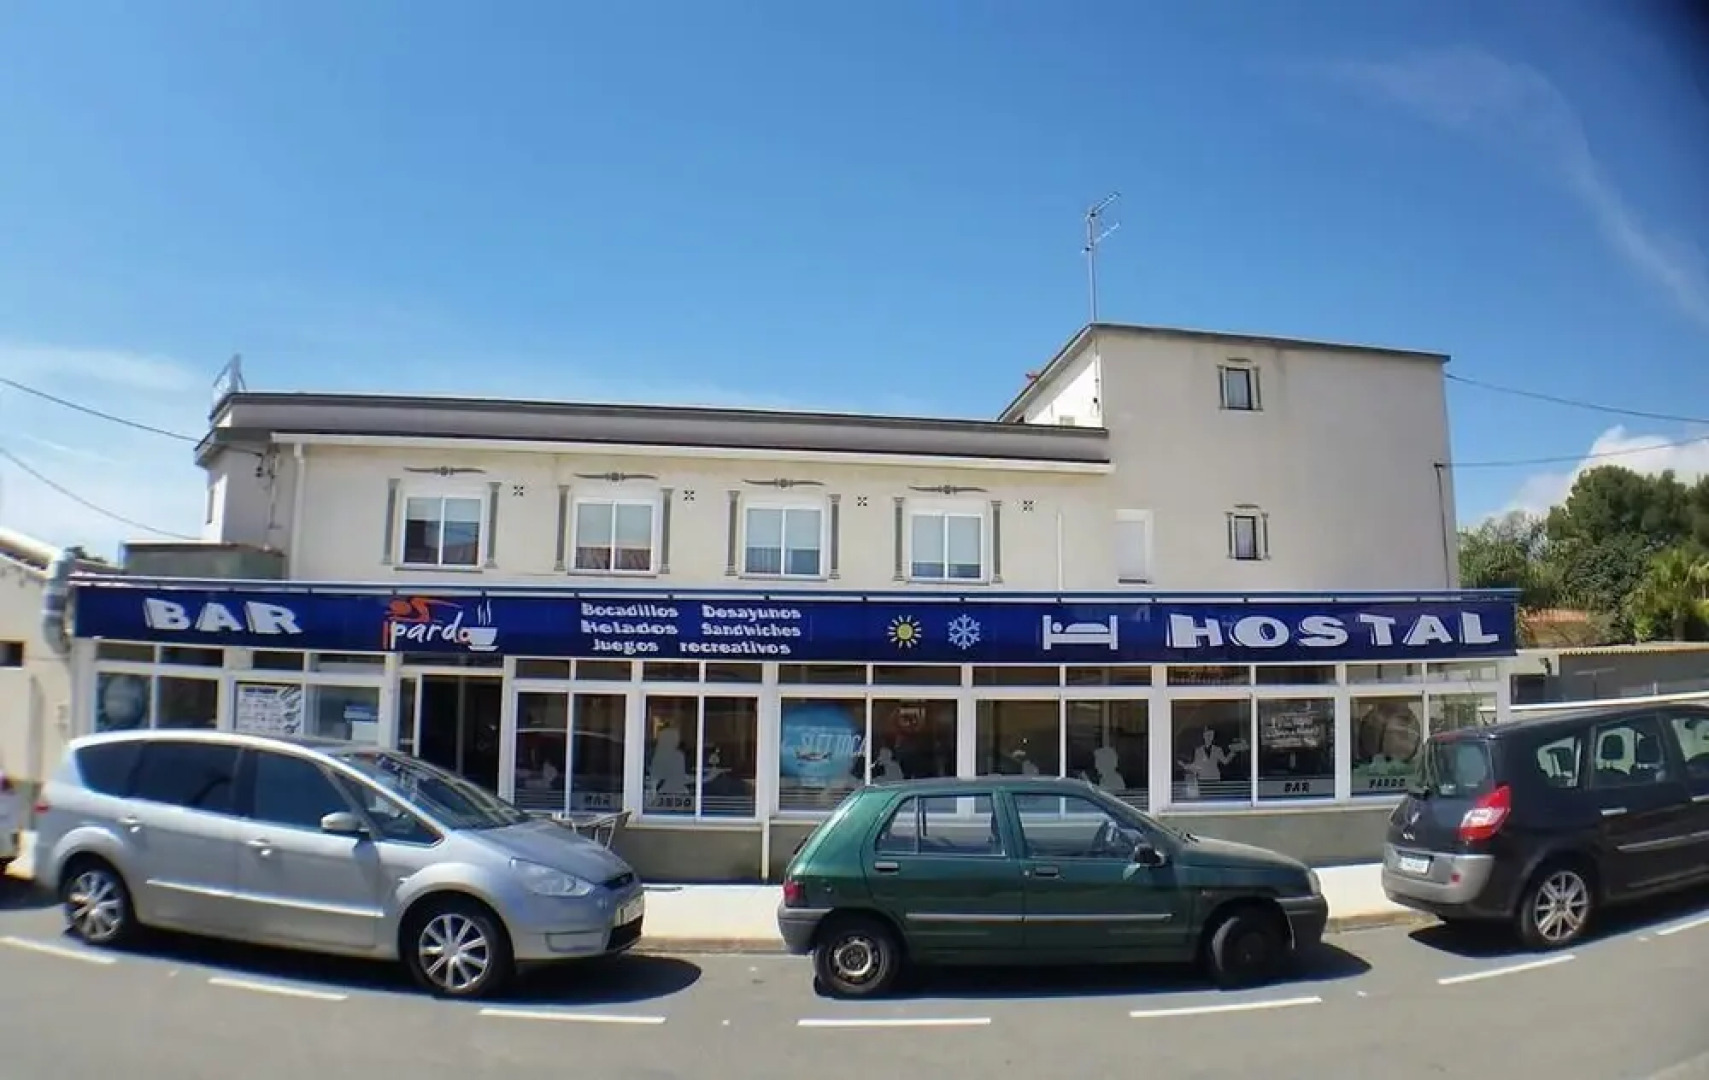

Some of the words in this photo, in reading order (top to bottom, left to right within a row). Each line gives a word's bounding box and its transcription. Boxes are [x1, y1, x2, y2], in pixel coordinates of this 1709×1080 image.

[144, 598, 303, 635] BAR
[580, 602, 679, 618] Bocadillos
[701, 604, 801, 622] Desayunos
[580, 619, 678, 635] Helados
[701, 622, 801, 637] Sandwiches
[1166, 611, 1500, 647] HOSTAL
[592, 638, 659, 655] Juegos
[679, 641, 792, 655] recreativos
[1284, 782, 1310, 793] BAR
